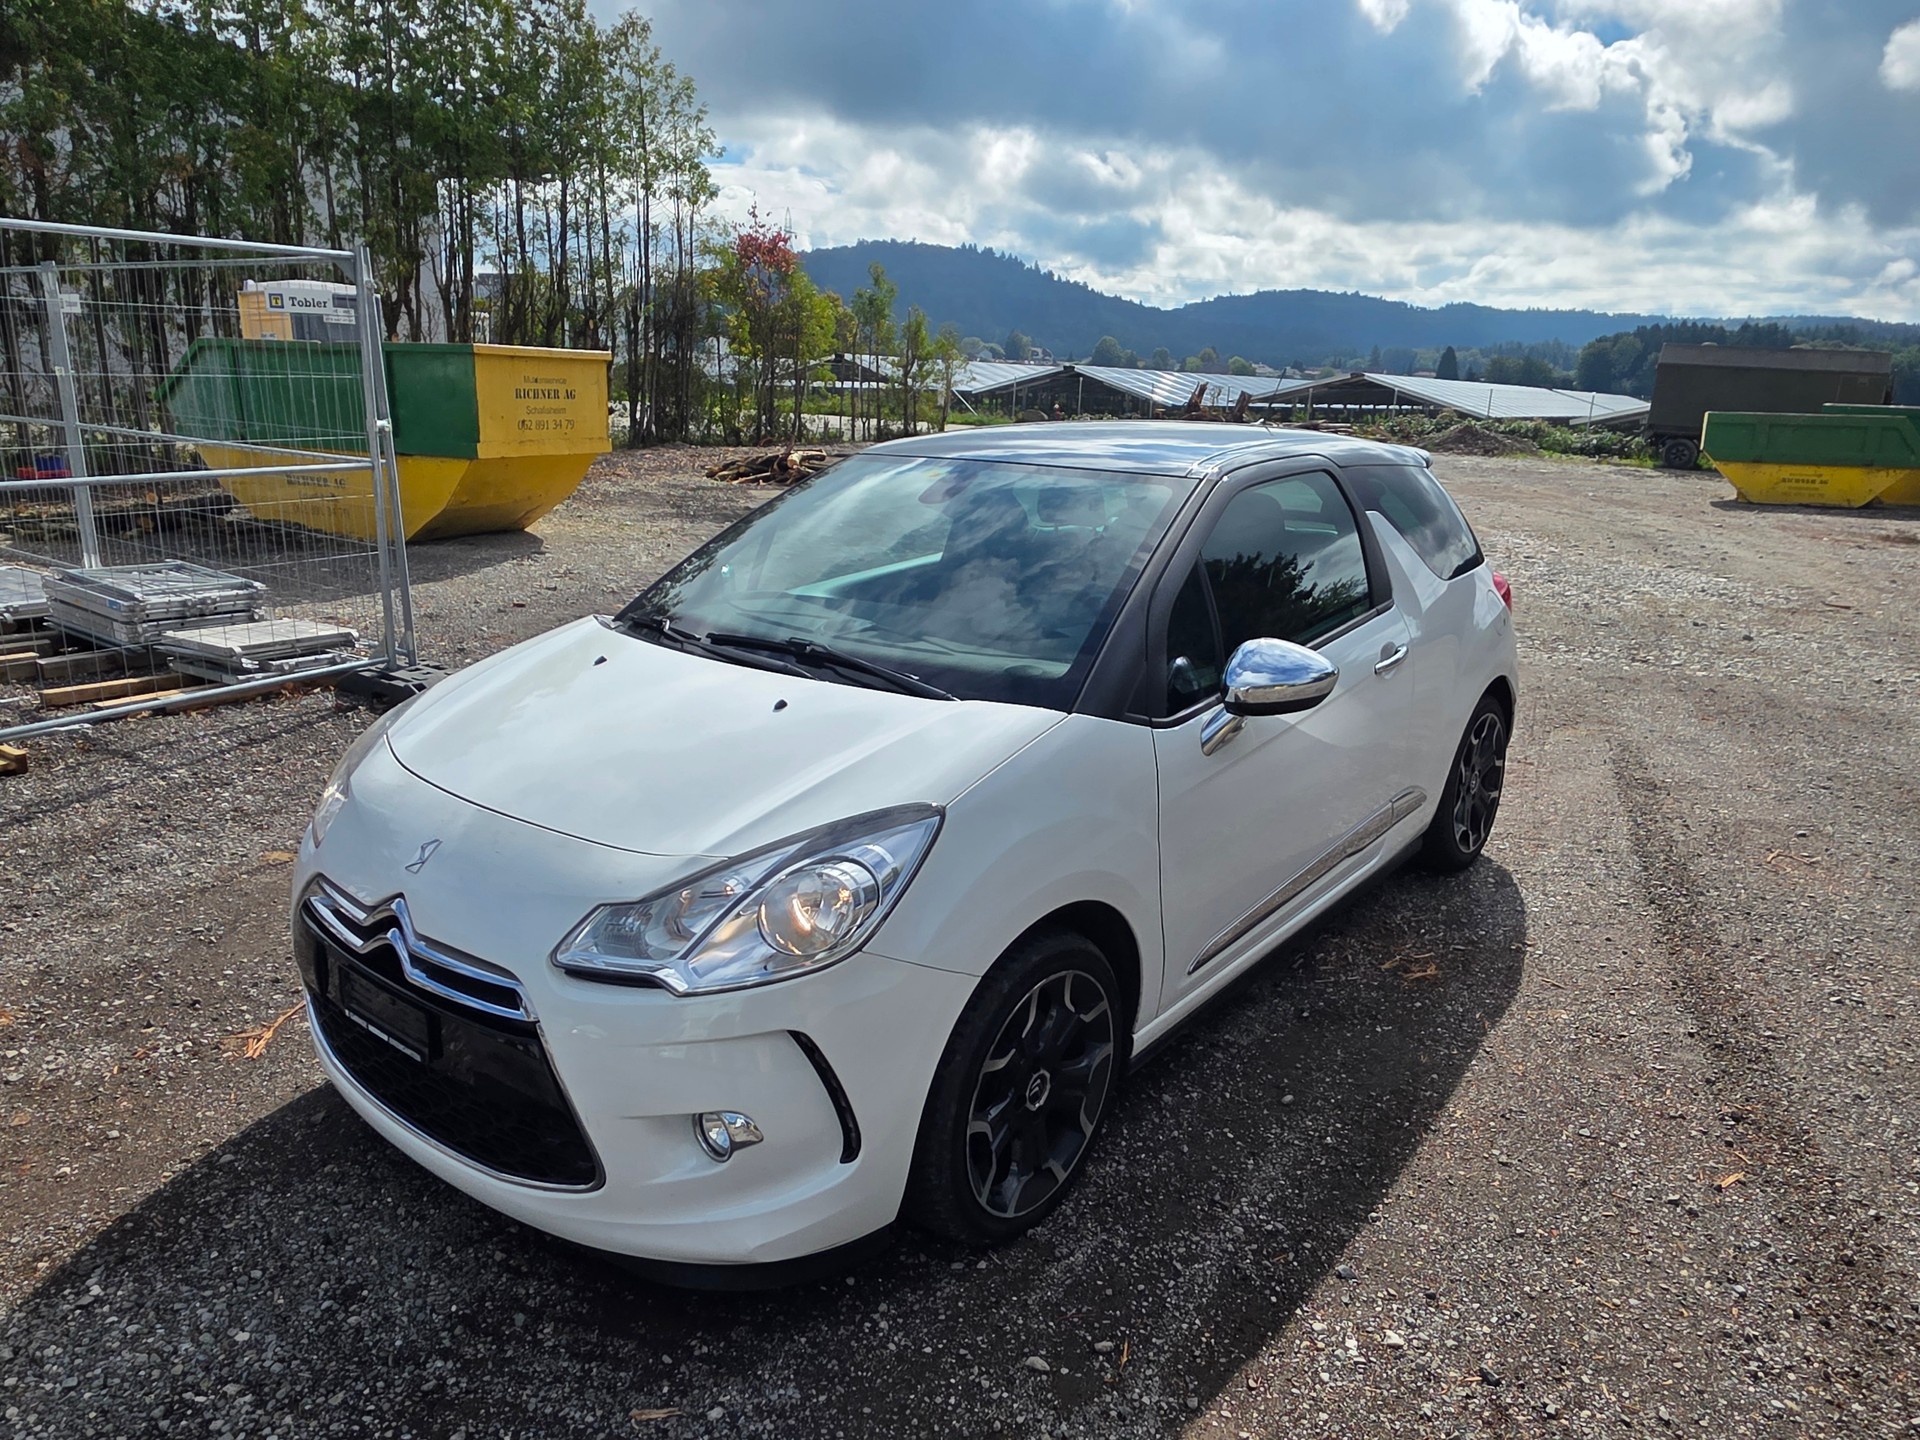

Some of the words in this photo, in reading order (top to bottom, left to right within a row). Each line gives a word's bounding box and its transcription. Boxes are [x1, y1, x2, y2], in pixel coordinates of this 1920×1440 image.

[288, 296, 328, 308] Tobler
[515, 388, 560, 400] RICHNER
[563, 388, 576, 400] AG
[535, 418, 549, 431] 891
[552, 418, 563, 430] 34
[565, 418, 575, 430] 79
